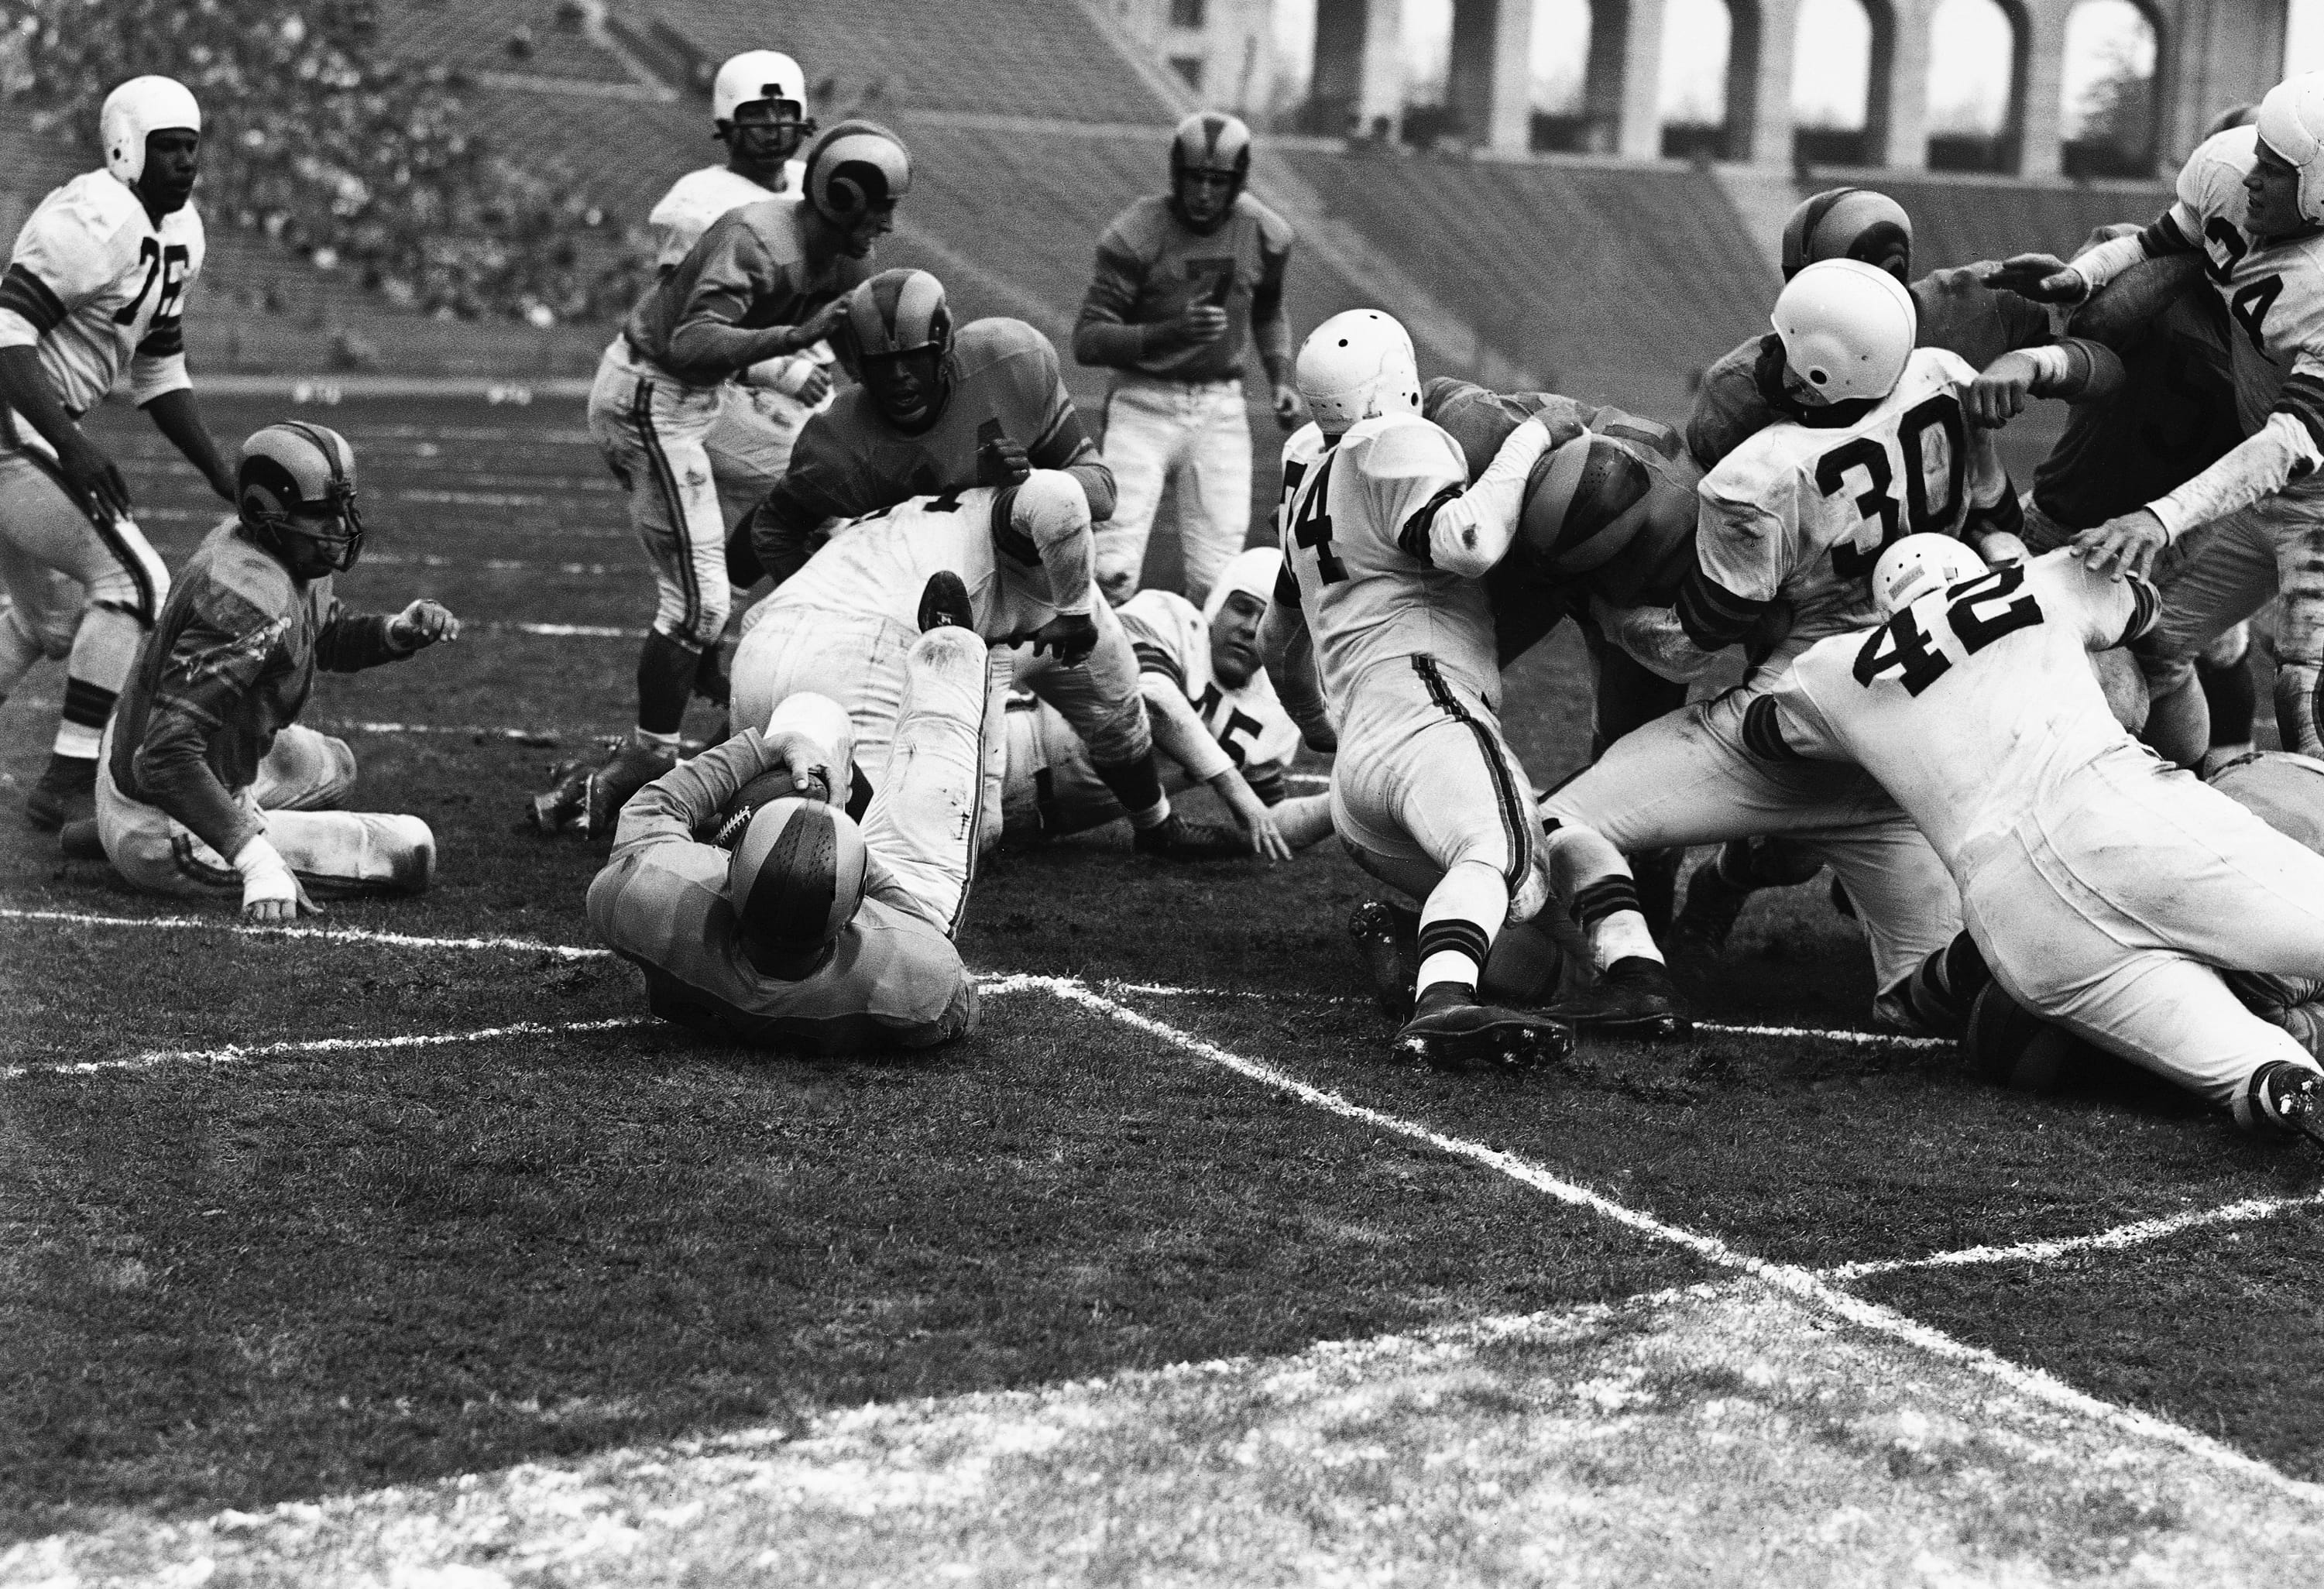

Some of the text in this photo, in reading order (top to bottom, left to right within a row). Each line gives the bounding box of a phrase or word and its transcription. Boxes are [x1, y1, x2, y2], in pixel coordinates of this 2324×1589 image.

[1280, 448, 1349, 589] 74
[1814, 393, 1965, 578] 30
[1852, 565, 2044, 697] 42
